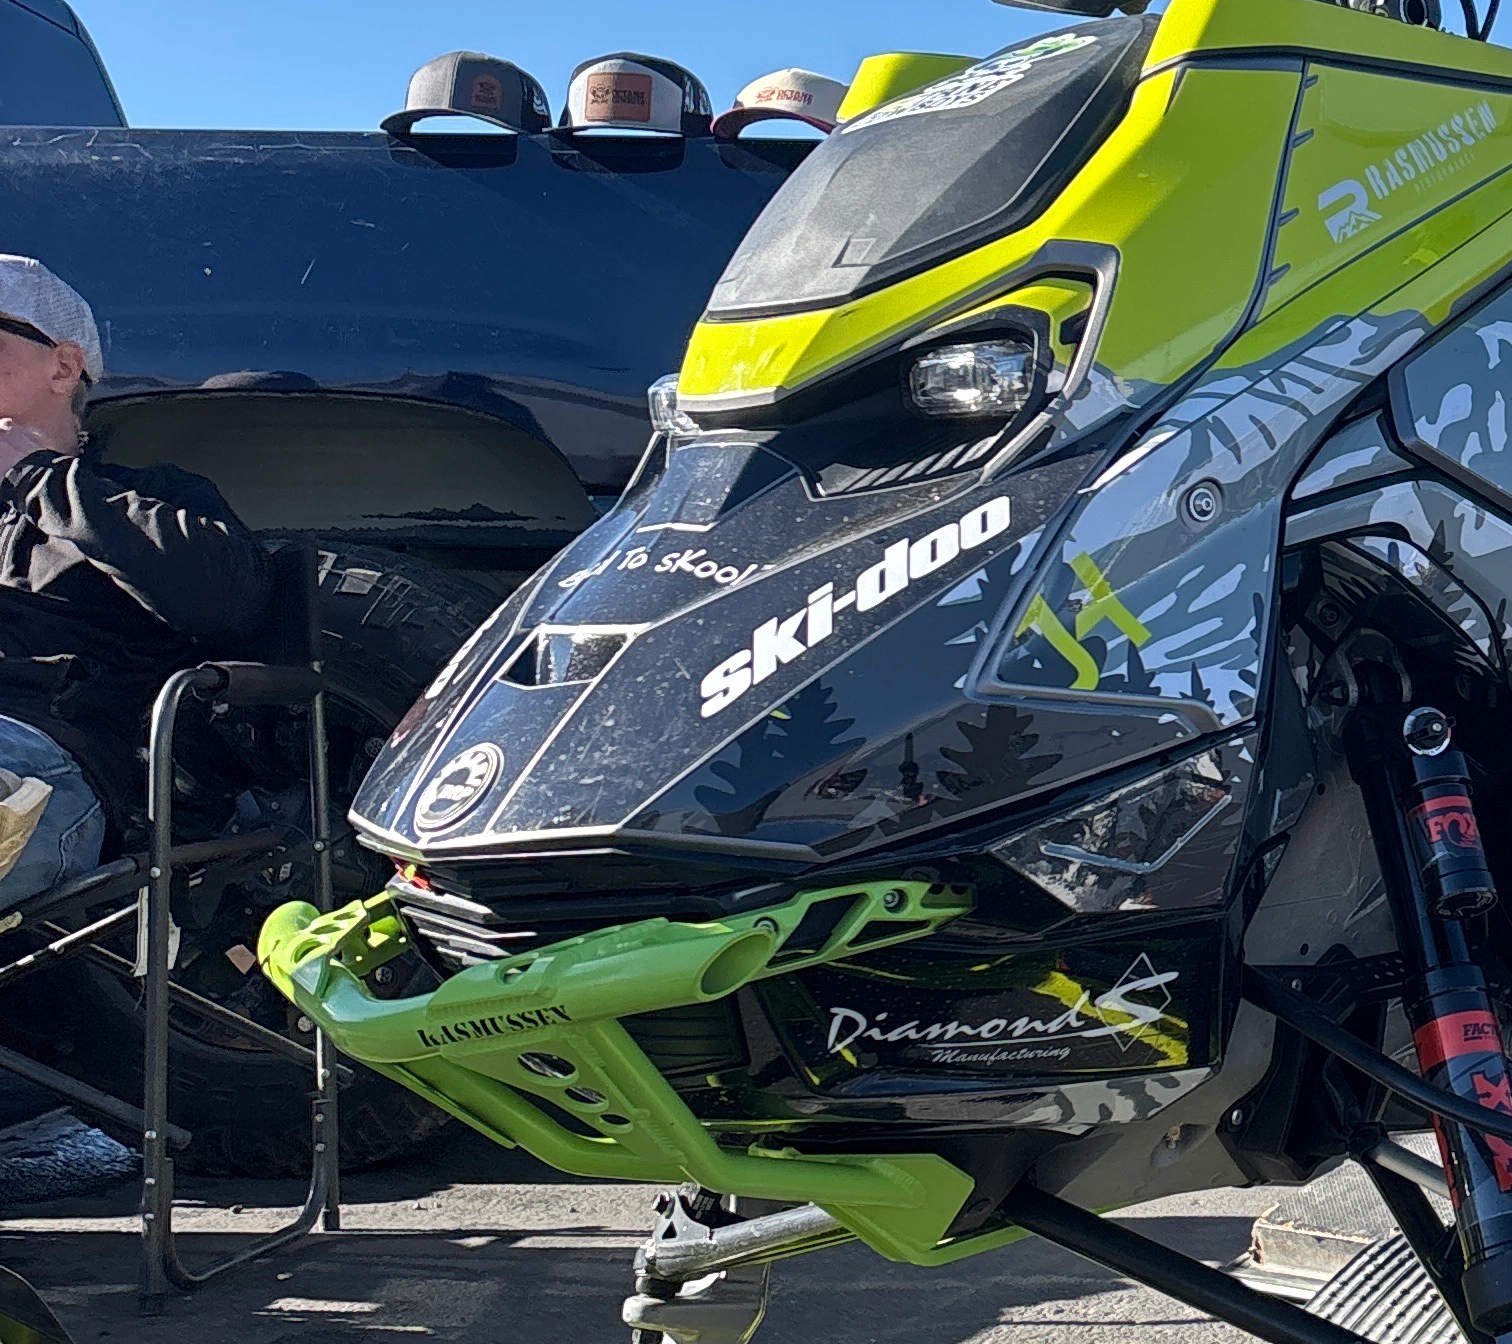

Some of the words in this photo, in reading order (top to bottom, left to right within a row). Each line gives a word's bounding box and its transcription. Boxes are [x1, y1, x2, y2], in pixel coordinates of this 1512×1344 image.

[1364, 99, 1497, 200] RASMUSSEN
[700, 494, 1012, 719] ski-doo
[1426, 811, 1480, 847] FOX
[417, 1005, 573, 1048] RASMUSSEN
[827, 989, 1090, 1053] Diamond
[1462, 1020, 1499, 1042] FACT
[931, 1045, 1071, 1066] Manufacturing
